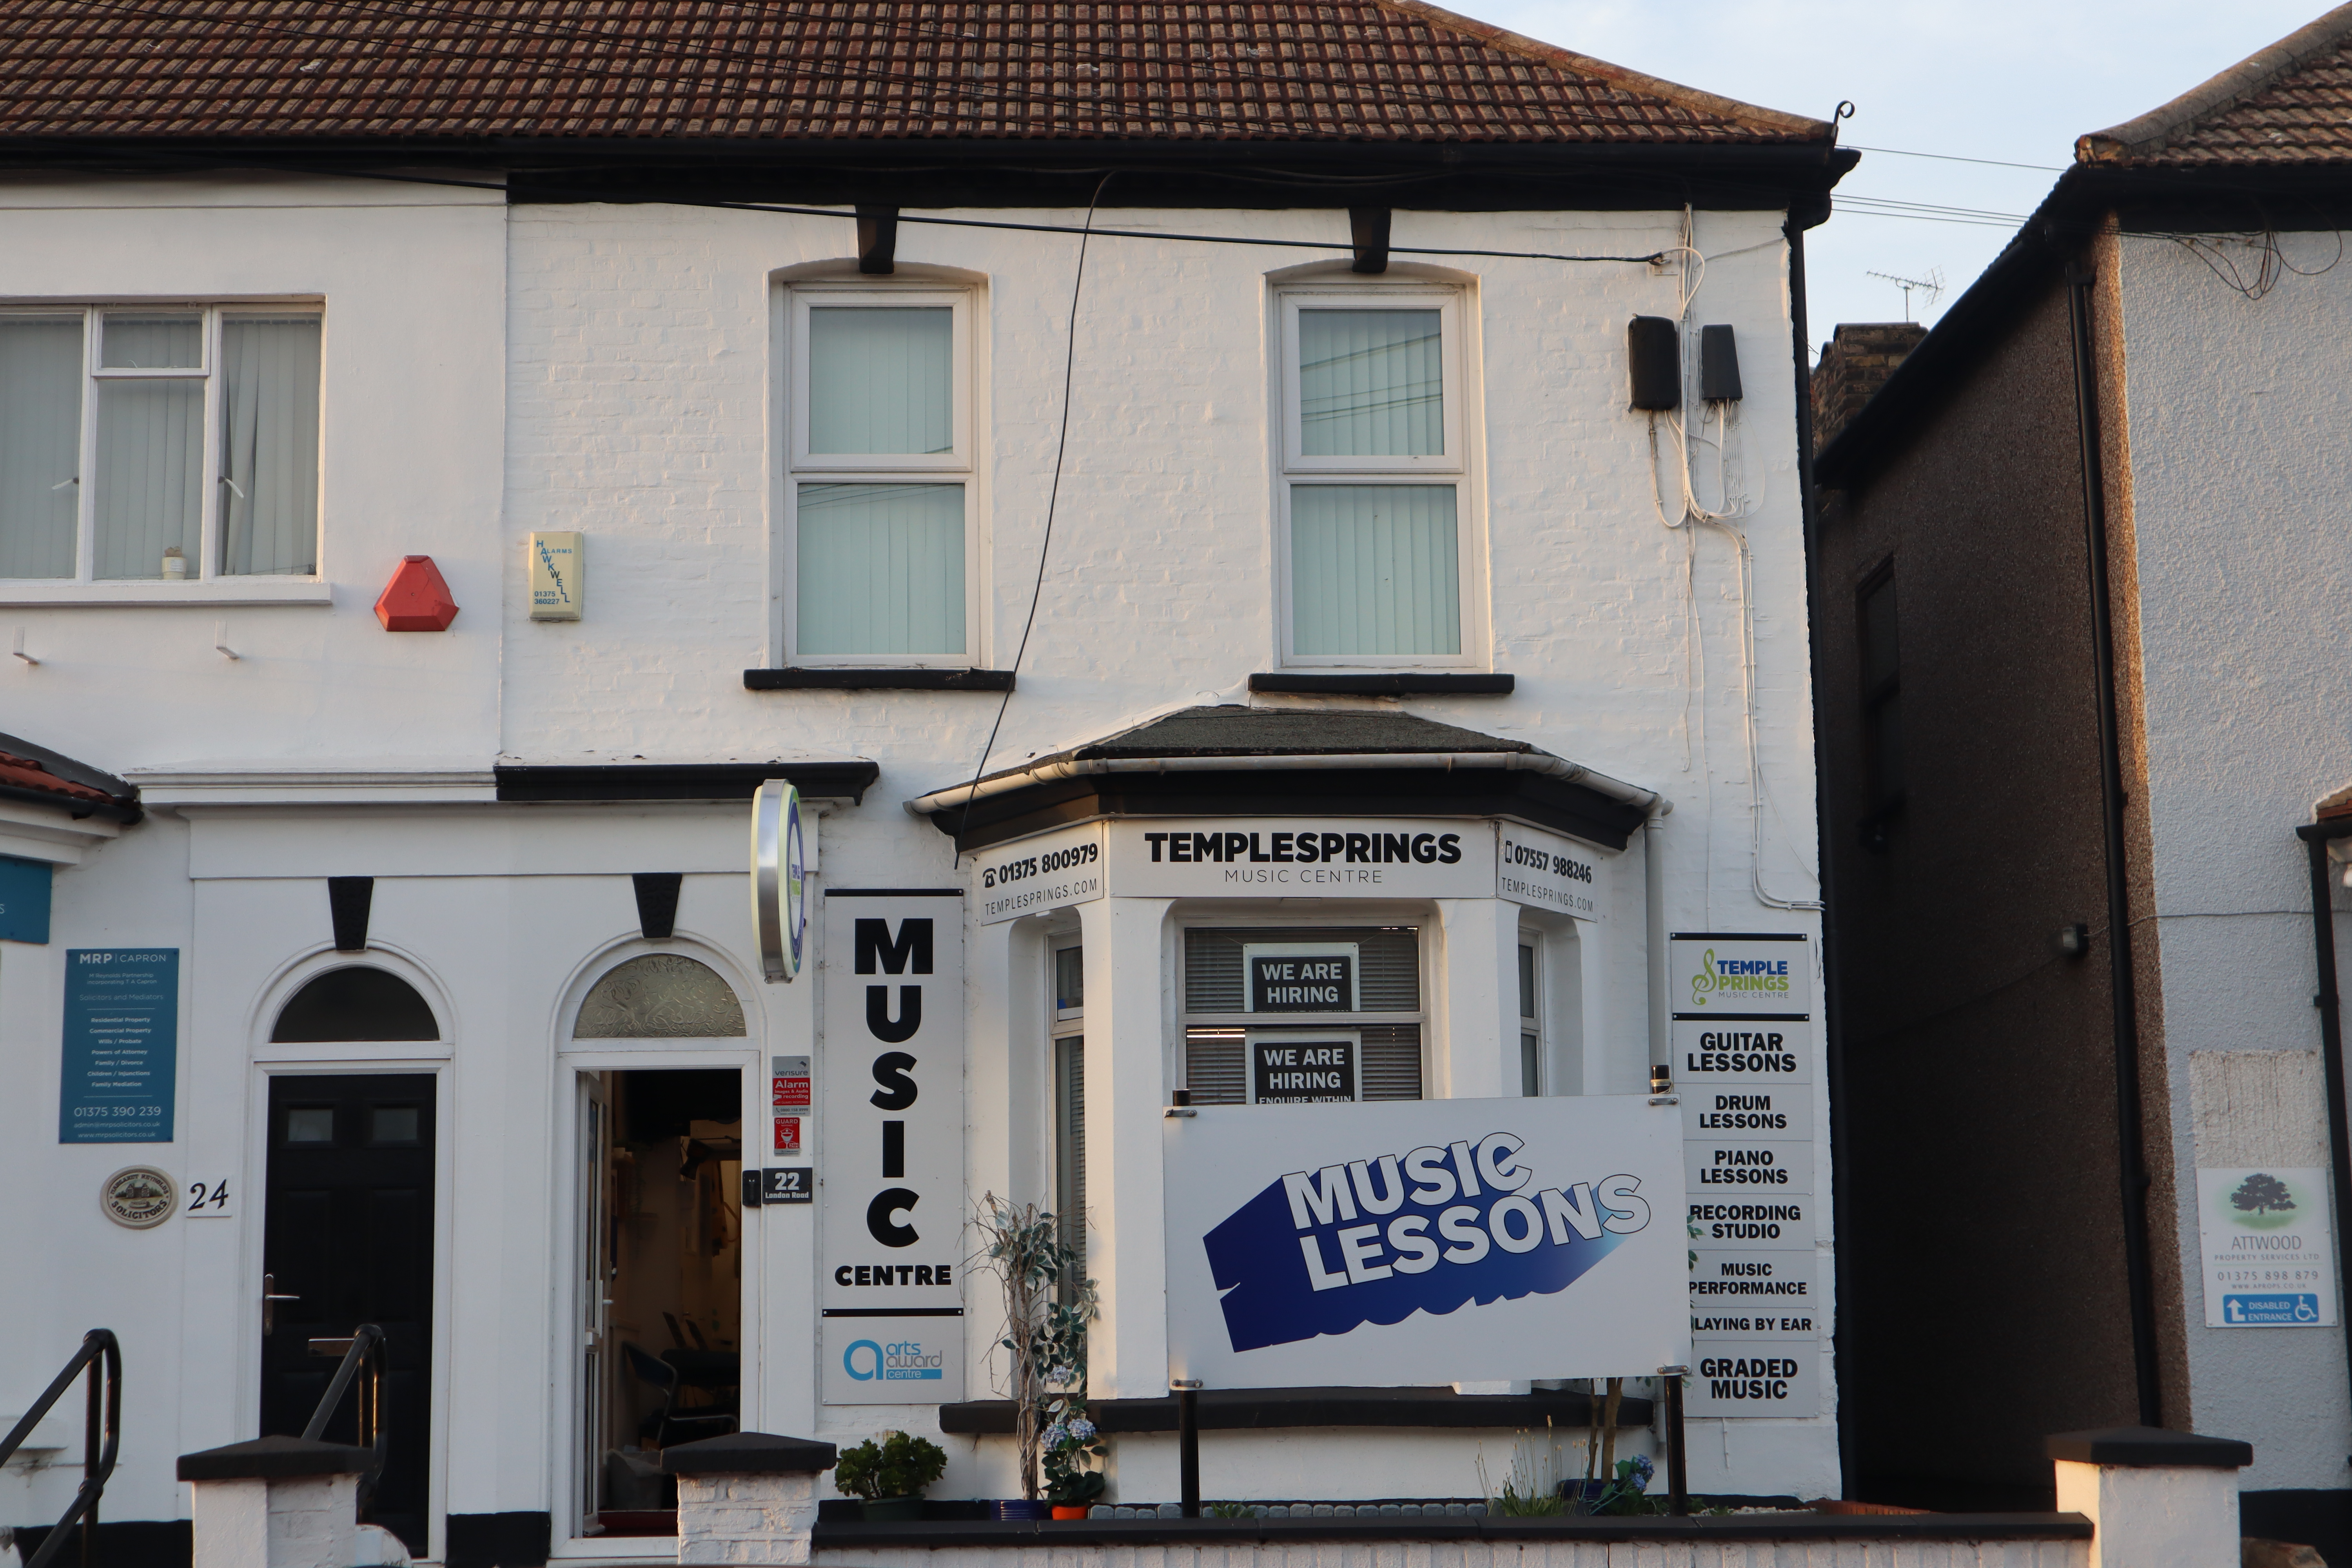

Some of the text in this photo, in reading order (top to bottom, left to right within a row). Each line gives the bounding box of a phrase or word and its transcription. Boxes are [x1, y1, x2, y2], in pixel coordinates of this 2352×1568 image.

[1145, 833, 1462, 864] TEMPLESPRINGS
[999, 843, 1098, 884] 01375 800979
[1515, 845, 1592, 884] 07557 988246
[1225, 870, 1382, 883] MUSIC CENTRE
[985, 878, 1097, 915] TEMPLESPRINGS.COM
[1502, 877, 1593, 913] TEMPLESPRINGS.COM
[80, 953, 166, 964] MRP CAPRON
[1261, 963, 1342, 980] WE ARE
[1717, 960, 1788, 975] TEMPLE
[1267, 986, 1338, 1003] HIRING
[1700, 1032, 1783, 1051] GUITAR
[1263, 1049, 1345, 1066] WE ARE
[1688, 1053, 1796, 1072] LESSONS
[775, 1080, 808, 1088] Alarm
[855, 918, 933, 1247] MUSIC
[1269, 1072, 1341, 1089] HIRING
[74, 1106, 161, 1116] 01375 390 239
[1716, 1096, 1770, 1110] DRUM
[1700, 1114, 1787, 1129] LESSONS
[1715, 1151, 1773, 1165] PIANO
[141, 1174, 168, 1194] REYNOLDS
[775, 1172, 799, 1190] 22
[1281, 1132, 1532, 1230] MUSIC
[1700, 1169, 1788, 1184] LESSONS
[188, 1178, 229, 1211] 24
[112, 1199, 167, 1219] SOLICITORS
[1690, 1205, 1800, 1220] RECORDING
[1299, 1174, 1651, 1292] LESSONS
[1712, 1223, 1780, 1239] STUDIO
[2231, 1236, 2301, 1250] ATTWOOD
[835, 1265, 951, 1286] CENTRE
[1721, 1263, 1772, 1276] MUSIC
[2218, 1271, 2319, 1281] 01375 898 879
[1689, 1282, 1807, 1295] PERFORMANCE
[1693, 1318, 1812, 1331] LAYING BY EAR
[2248, 1313, 2292, 1321] ENTRANCE
[886, 1341, 921, 1356] arts
[886, 1350, 942, 1368] award
[888, 1368, 921, 1379] centre
[1700, 1358, 1798, 1378] GRADED
[1711, 1380, 1788, 1399] MUSIC
